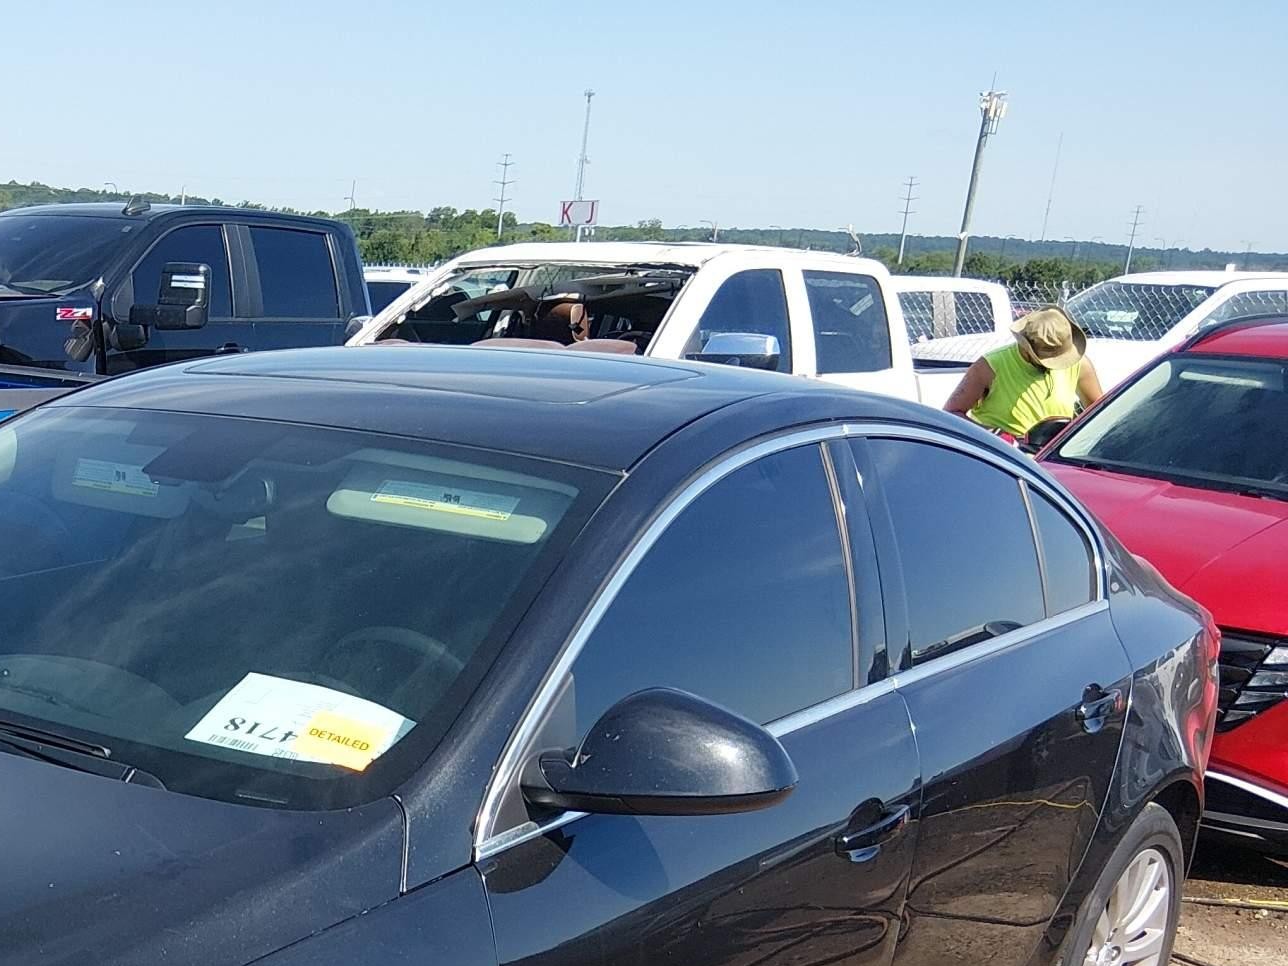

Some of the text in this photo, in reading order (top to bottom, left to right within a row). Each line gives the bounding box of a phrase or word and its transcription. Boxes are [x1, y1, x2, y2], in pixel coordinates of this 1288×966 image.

[561, 201, 595, 224] K J
[223, 716, 299, 743] 4718
[308, 727, 370, 751] DETAILED
